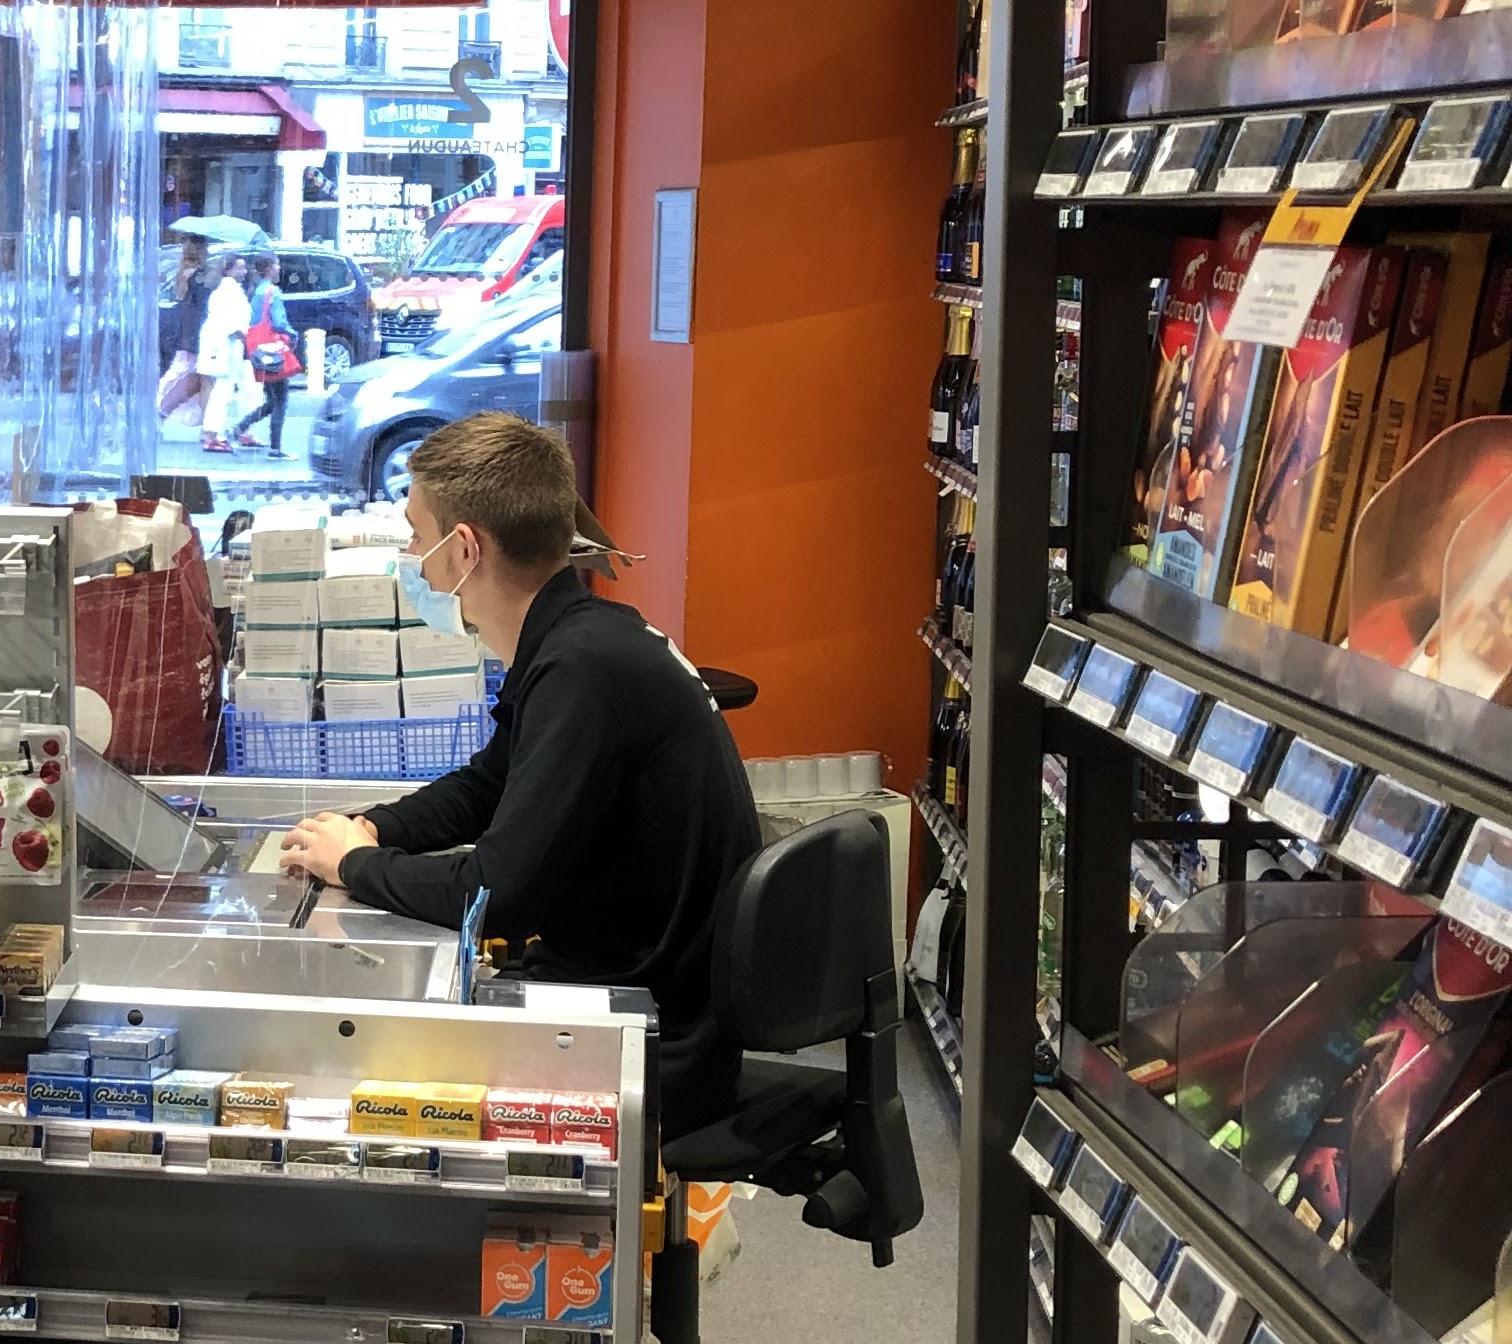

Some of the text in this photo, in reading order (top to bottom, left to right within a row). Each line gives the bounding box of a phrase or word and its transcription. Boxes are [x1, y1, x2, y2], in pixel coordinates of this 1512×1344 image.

[1346, 389, 1363, 420] LAIT
[1168, 503, 1184, 522] LAIT
[31, 1083, 82, 1103] Ricola
[94, 1085, 147, 1105] Ricola
[158, 1090, 210, 1107] Ricola
[226, 1092, 279, 1107] Ricola
[356, 1099, 408, 1117] Ricola
[421, 1105, 475, 1123] Ricola
[491, 1106, 545, 1124] Ricola
[556, 1108, 611, 1127] Ricola
[499, 1126, 536, 1138] Cranberry
[564, 1129, 601, 1142] Cranberry
[496, 1271, 519, 1281] One
[561, 1276, 585, 1287] One
[504, 1281, 530, 1290] Gum
[569, 1286, 596, 1296] Gum
